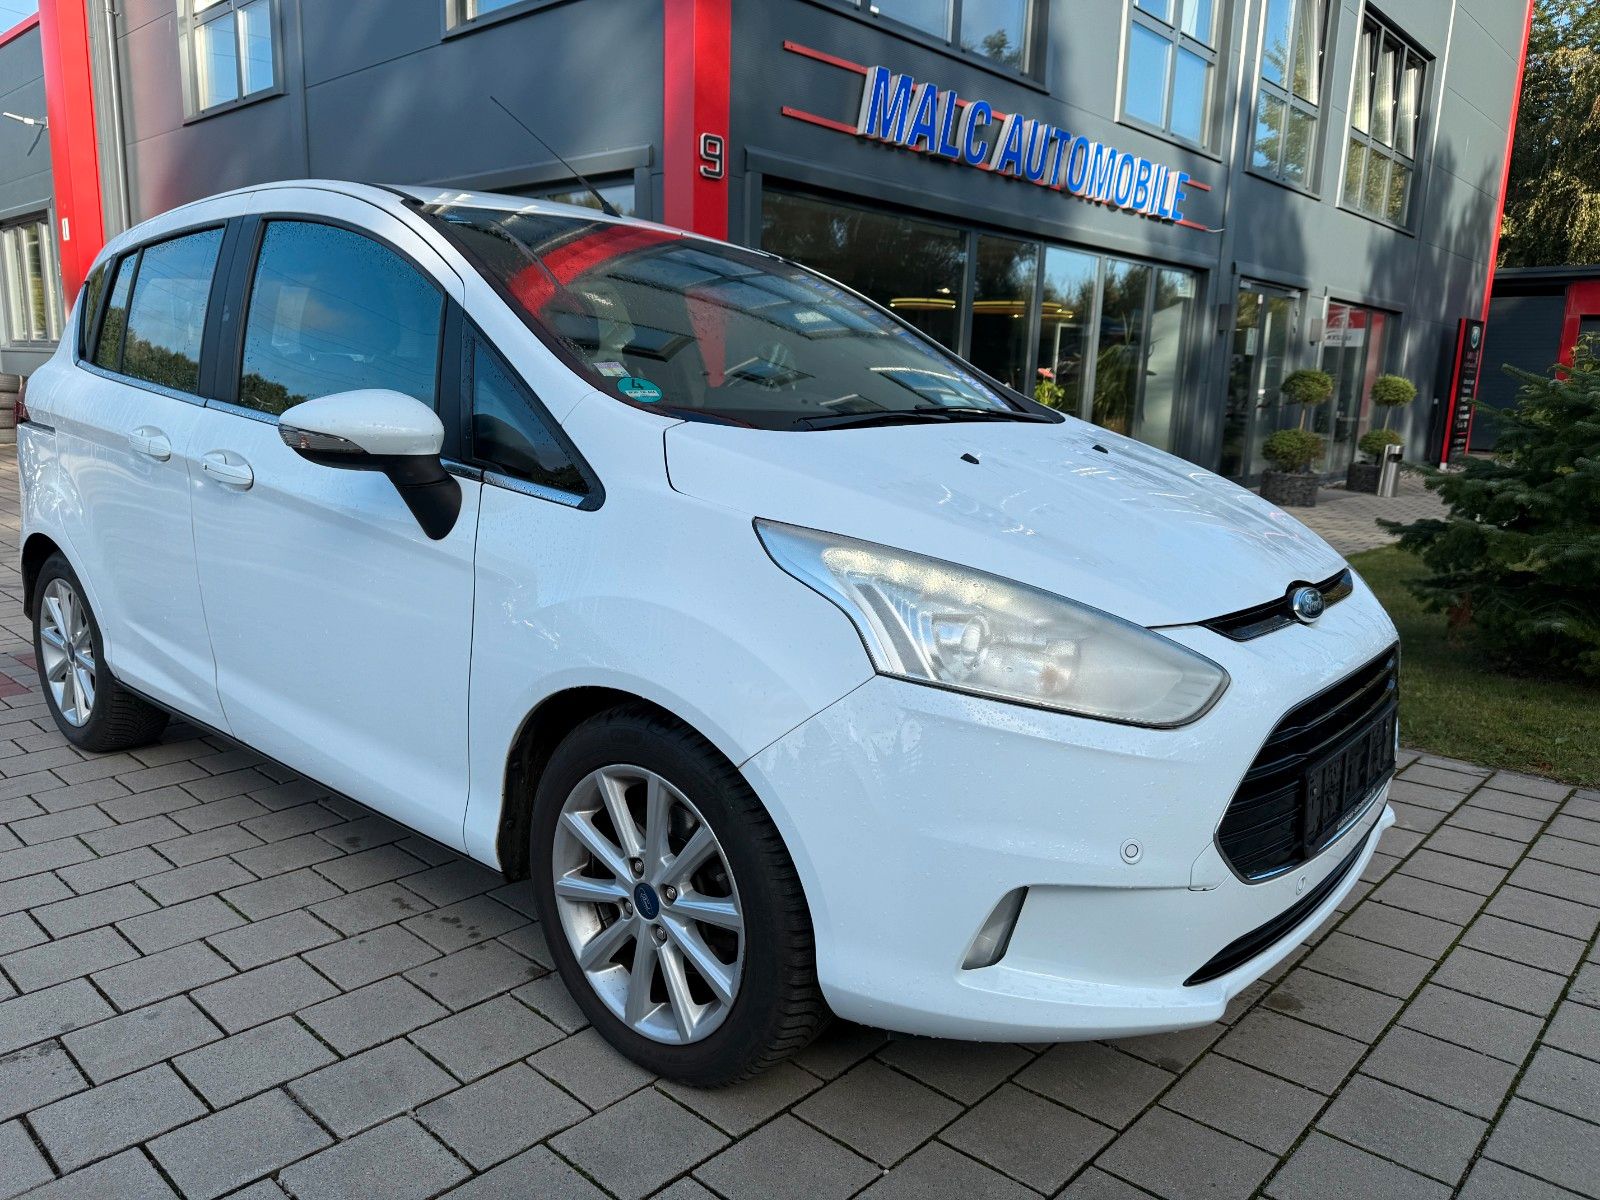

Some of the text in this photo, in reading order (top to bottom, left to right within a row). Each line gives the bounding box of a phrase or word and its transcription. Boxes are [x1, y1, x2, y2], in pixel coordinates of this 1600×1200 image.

[699, 132, 724, 179] 9
[859, 65, 1191, 222] MALC AUTOMOBILE
